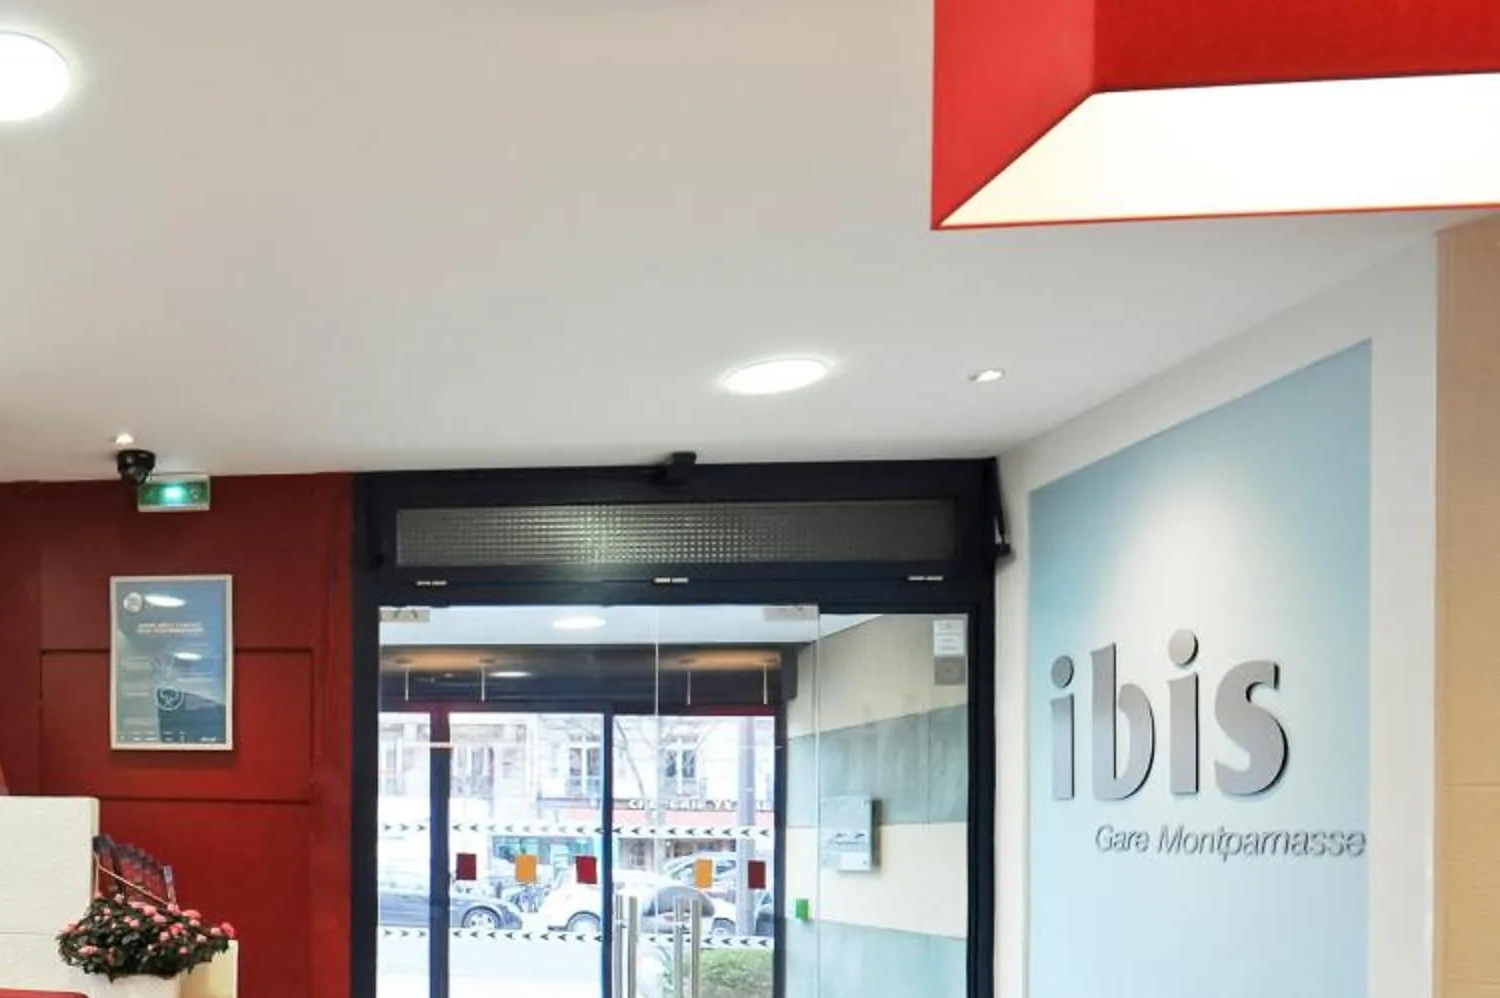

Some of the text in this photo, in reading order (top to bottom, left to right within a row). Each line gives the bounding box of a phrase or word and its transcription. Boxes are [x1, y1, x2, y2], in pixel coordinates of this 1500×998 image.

[1050, 628, 1289, 802] ibis
[1095, 825, 1367, 862] Gare Montparnasse
